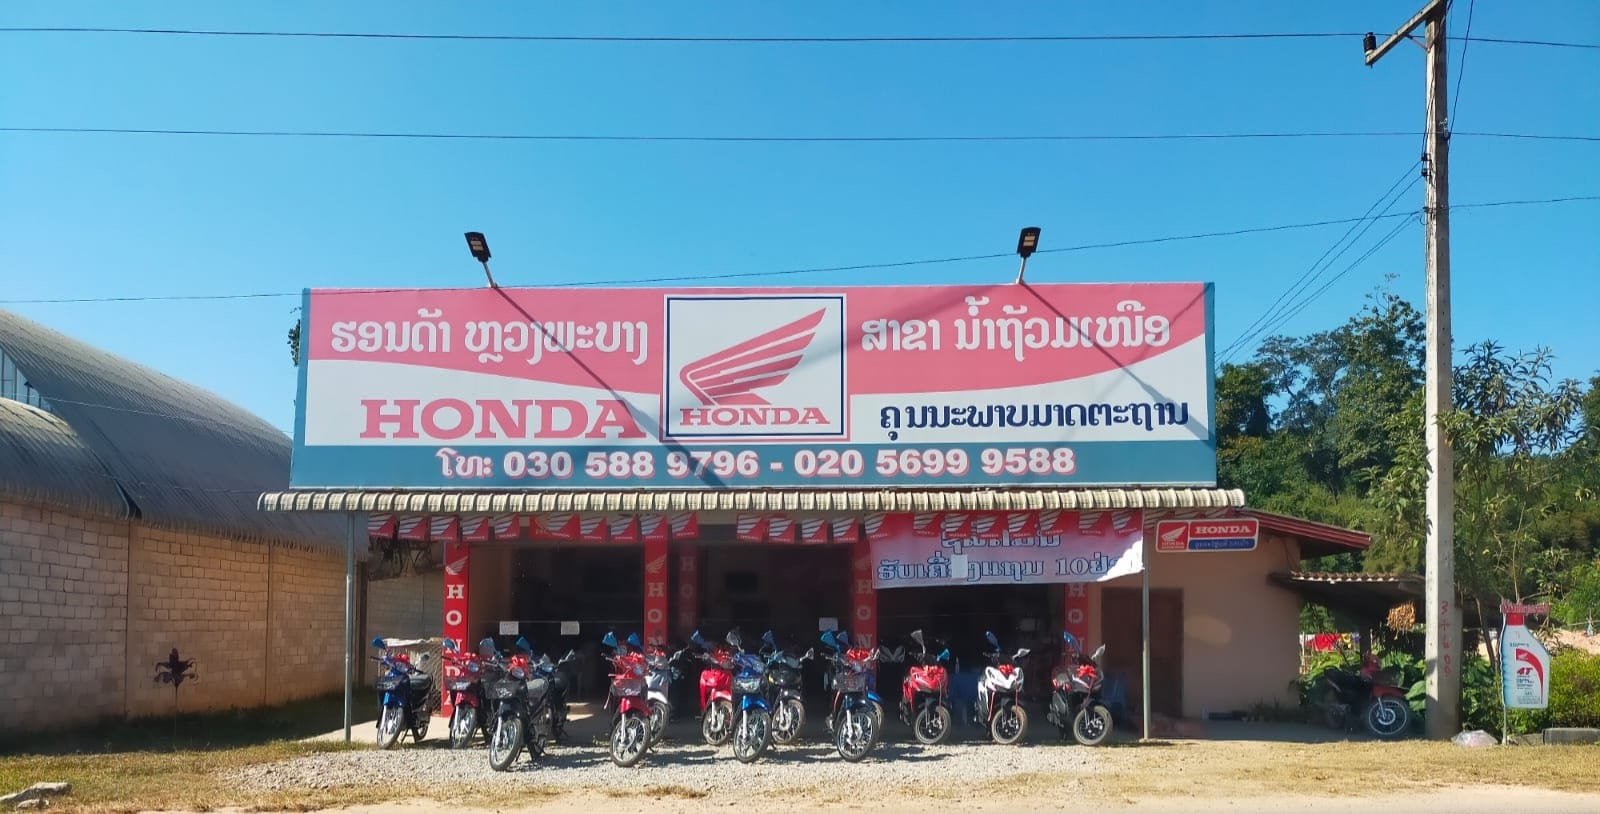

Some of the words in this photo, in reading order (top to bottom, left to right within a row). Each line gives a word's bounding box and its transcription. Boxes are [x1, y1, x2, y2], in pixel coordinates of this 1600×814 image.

[331, 308, 451, 352] ຮອນດ້າ
[861, 318, 941, 352] ສາຂາ
[359, 398, 647, 440] HONDA
[679, 407, 830, 427] HONDA
[503, 450, 573, 479] 030
[585, 450, 656, 479] 588
[666, 450, 760, 479] 9796
[793, 449, 865, 478] 020
[875, 449, 970, 478] 5699
[980, 447, 1076, 477] 9588
[1195, 525, 1251, 534] HONDA
